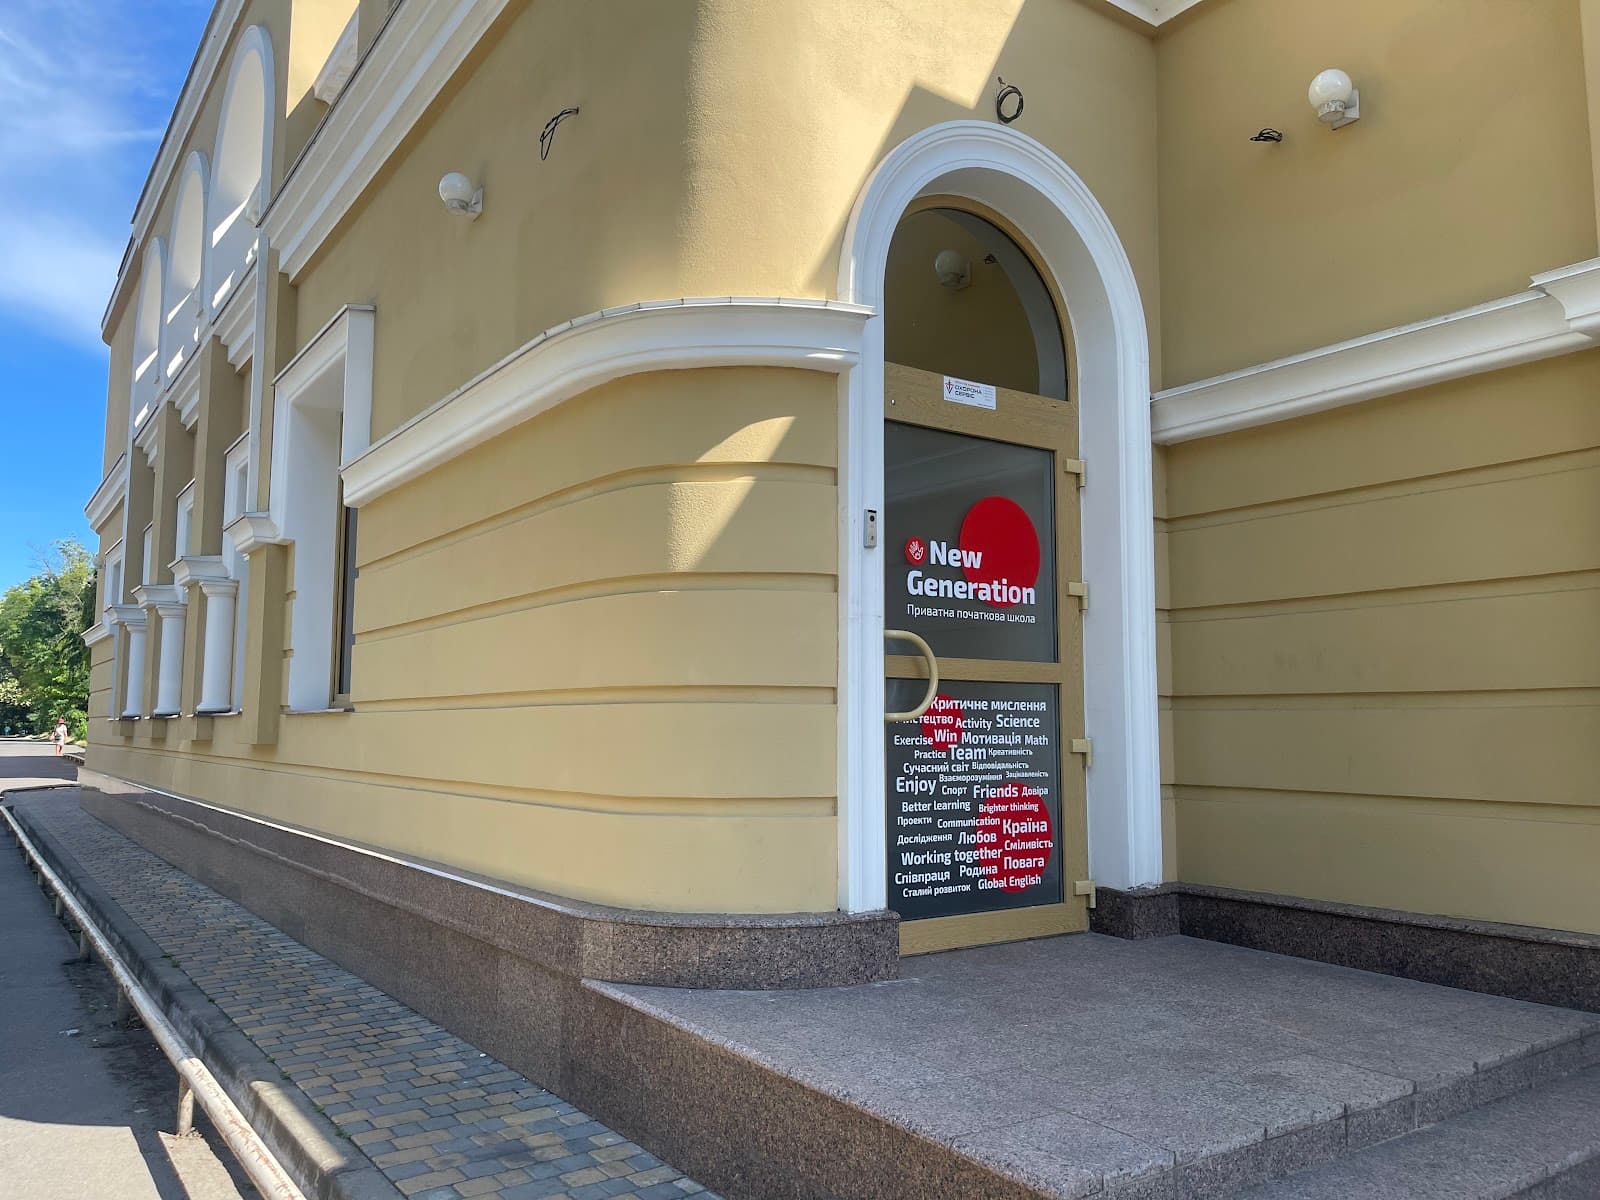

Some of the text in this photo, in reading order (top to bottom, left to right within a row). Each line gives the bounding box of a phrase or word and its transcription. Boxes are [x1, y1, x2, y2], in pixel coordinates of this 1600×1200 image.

[930, 540, 982, 569] New
[907, 571, 1035, 605] Generation
[907, 604, 1036, 624] Приватна початкова школа
[931, 697, 1046, 712] Критичне мислення
[955, 717, 992, 730] Activity
[996, 715, 1040, 728] Science
[894, 735, 933, 745] Exercise
[934, 729, 957, 742] Win
[962, 732, 1021, 746] Мотивація
[1025, 735, 1048, 745] Math
[914, 750, 946, 759] Practice
[948, 745, 986, 760] Team
[989, 748, 1033, 757] Креативність
[904, 762, 969, 775] Сучасний світ
[972, 761, 1029, 770] Відповідальність
[896, 776, 936, 795] Enjoy
[942, 786, 967, 796] Спорт
[974, 784, 1018, 798] Friends
[1022, 786, 1048, 797] Довіра
[902, 800, 971, 812] Better learning
[979, 802, 1039, 814] Brighter thinking
[897, 817, 932, 827] Проекти
[937, 816, 1000, 828] Communication
[1003, 819, 1047, 837] Країна
[897, 833, 952, 846] Дослідження
[958, 831, 997, 845] Любов
[1004, 839, 1053, 851] Сміливість
[902, 847, 1002, 866] Working together
[1004, 856, 1044, 870] Повага
[895, 870, 950, 885] Співпраця
[960, 864, 997, 878] Родина
[978, 874, 1041, 890] Global English
[903, 884, 971, 898] Сталий розвиток
